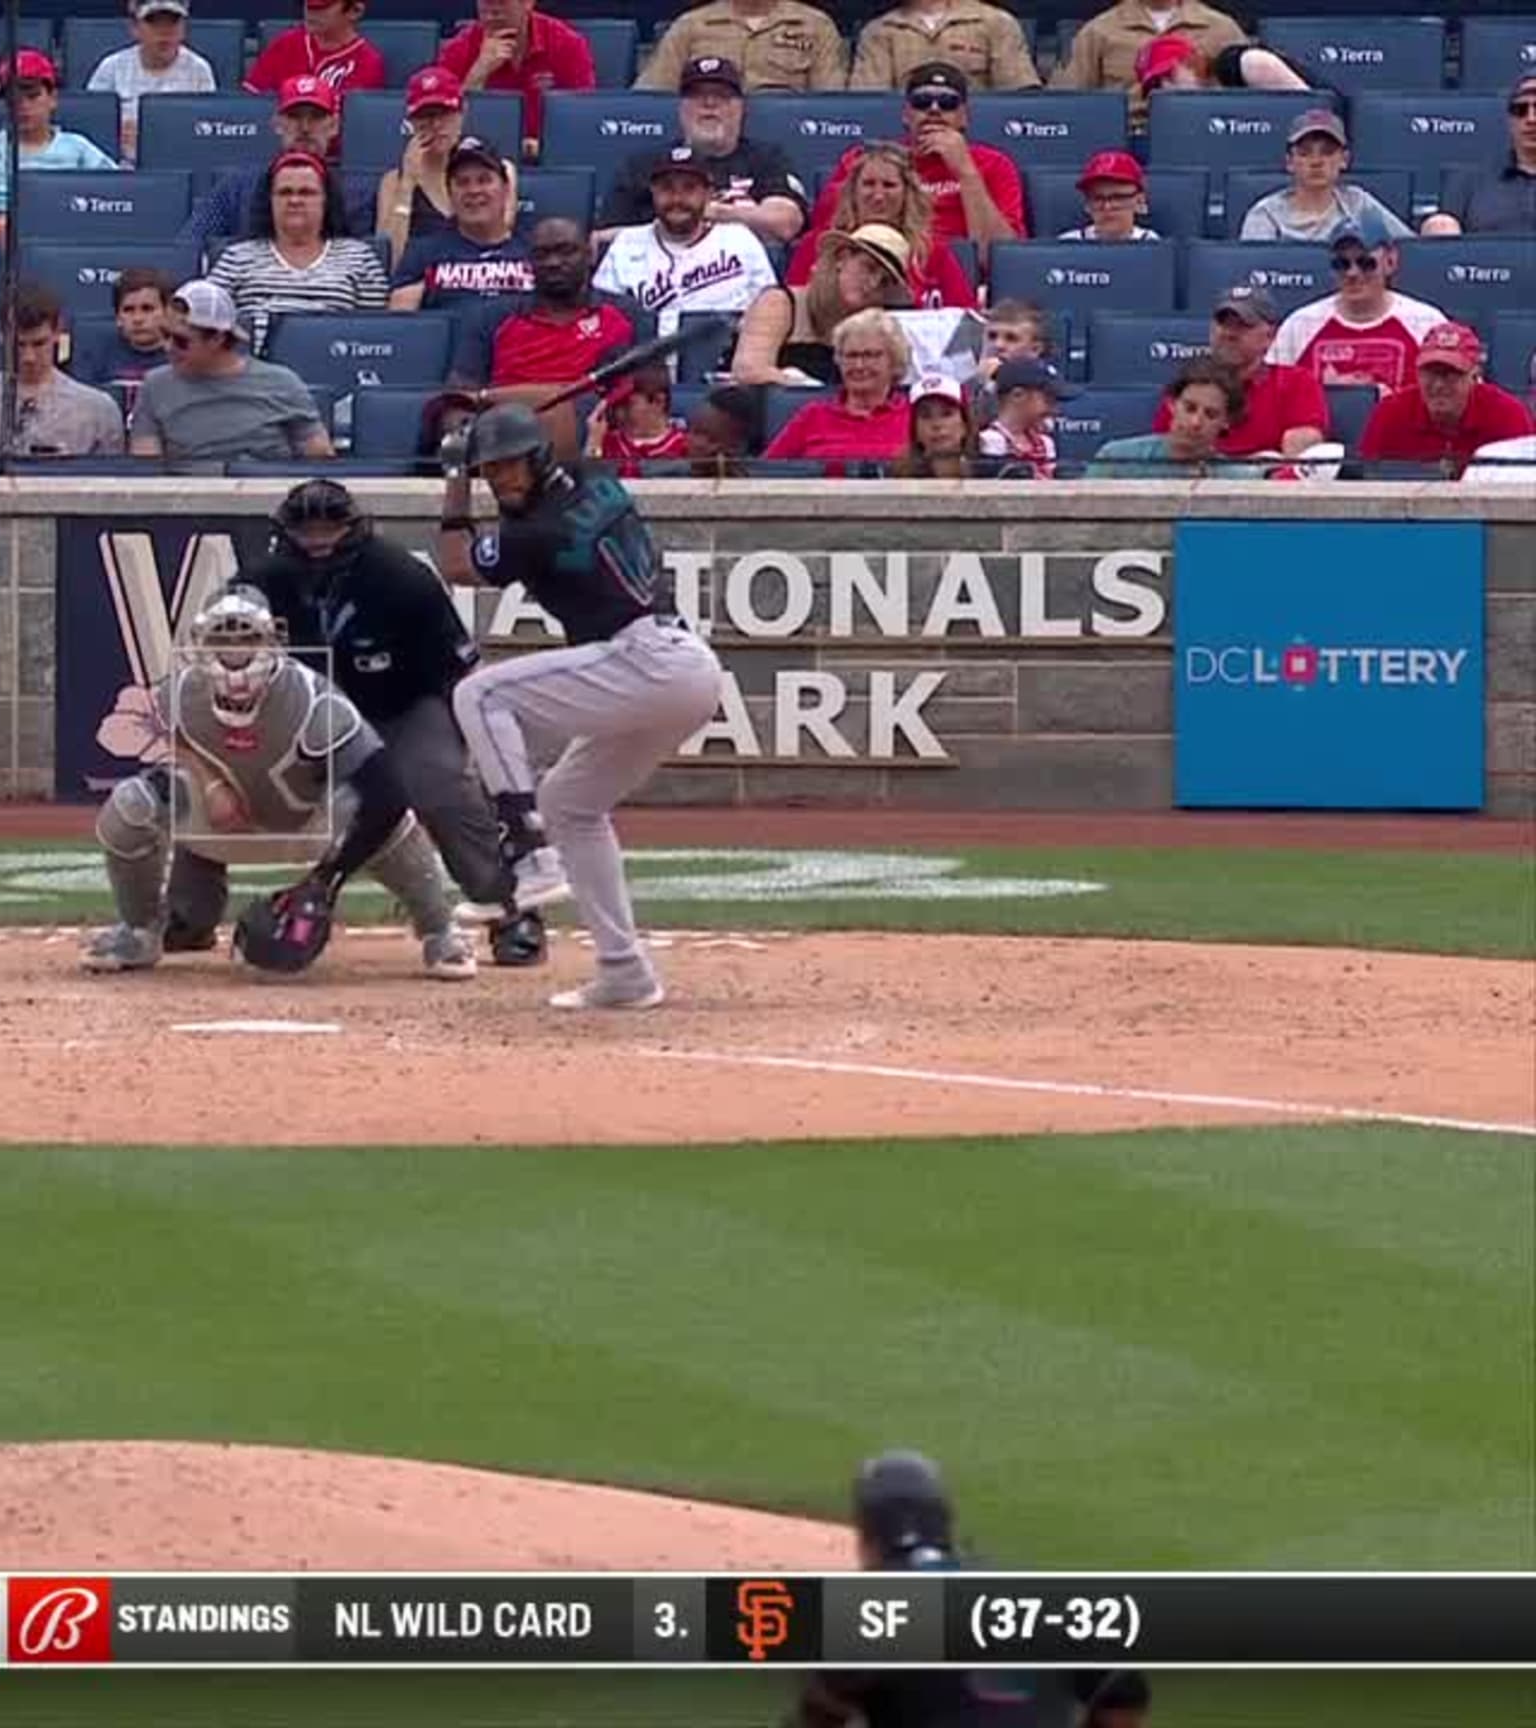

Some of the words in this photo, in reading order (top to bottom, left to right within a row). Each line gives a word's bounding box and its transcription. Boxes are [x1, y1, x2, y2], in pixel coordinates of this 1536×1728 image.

[1339, 49, 1384, 62] Terra
[214, 122, 258, 135] Terra
[619, 122, 663, 136] Terra
[820, 122, 863, 136] Terra
[1024, 121, 1068, 136] Terra
[1228, 120, 1271, 133] Terra
[1431, 119, 1475, 133] Terra
[89, 199, 133, 212] Terra
[1067, 270, 1111, 284] Terra
[1268, 272, 1313, 286] Terra
[1465, 266, 1511, 281] Terra
[1169, 345, 1212, 359] Terr
[677, 670, 949, 759] ARK
